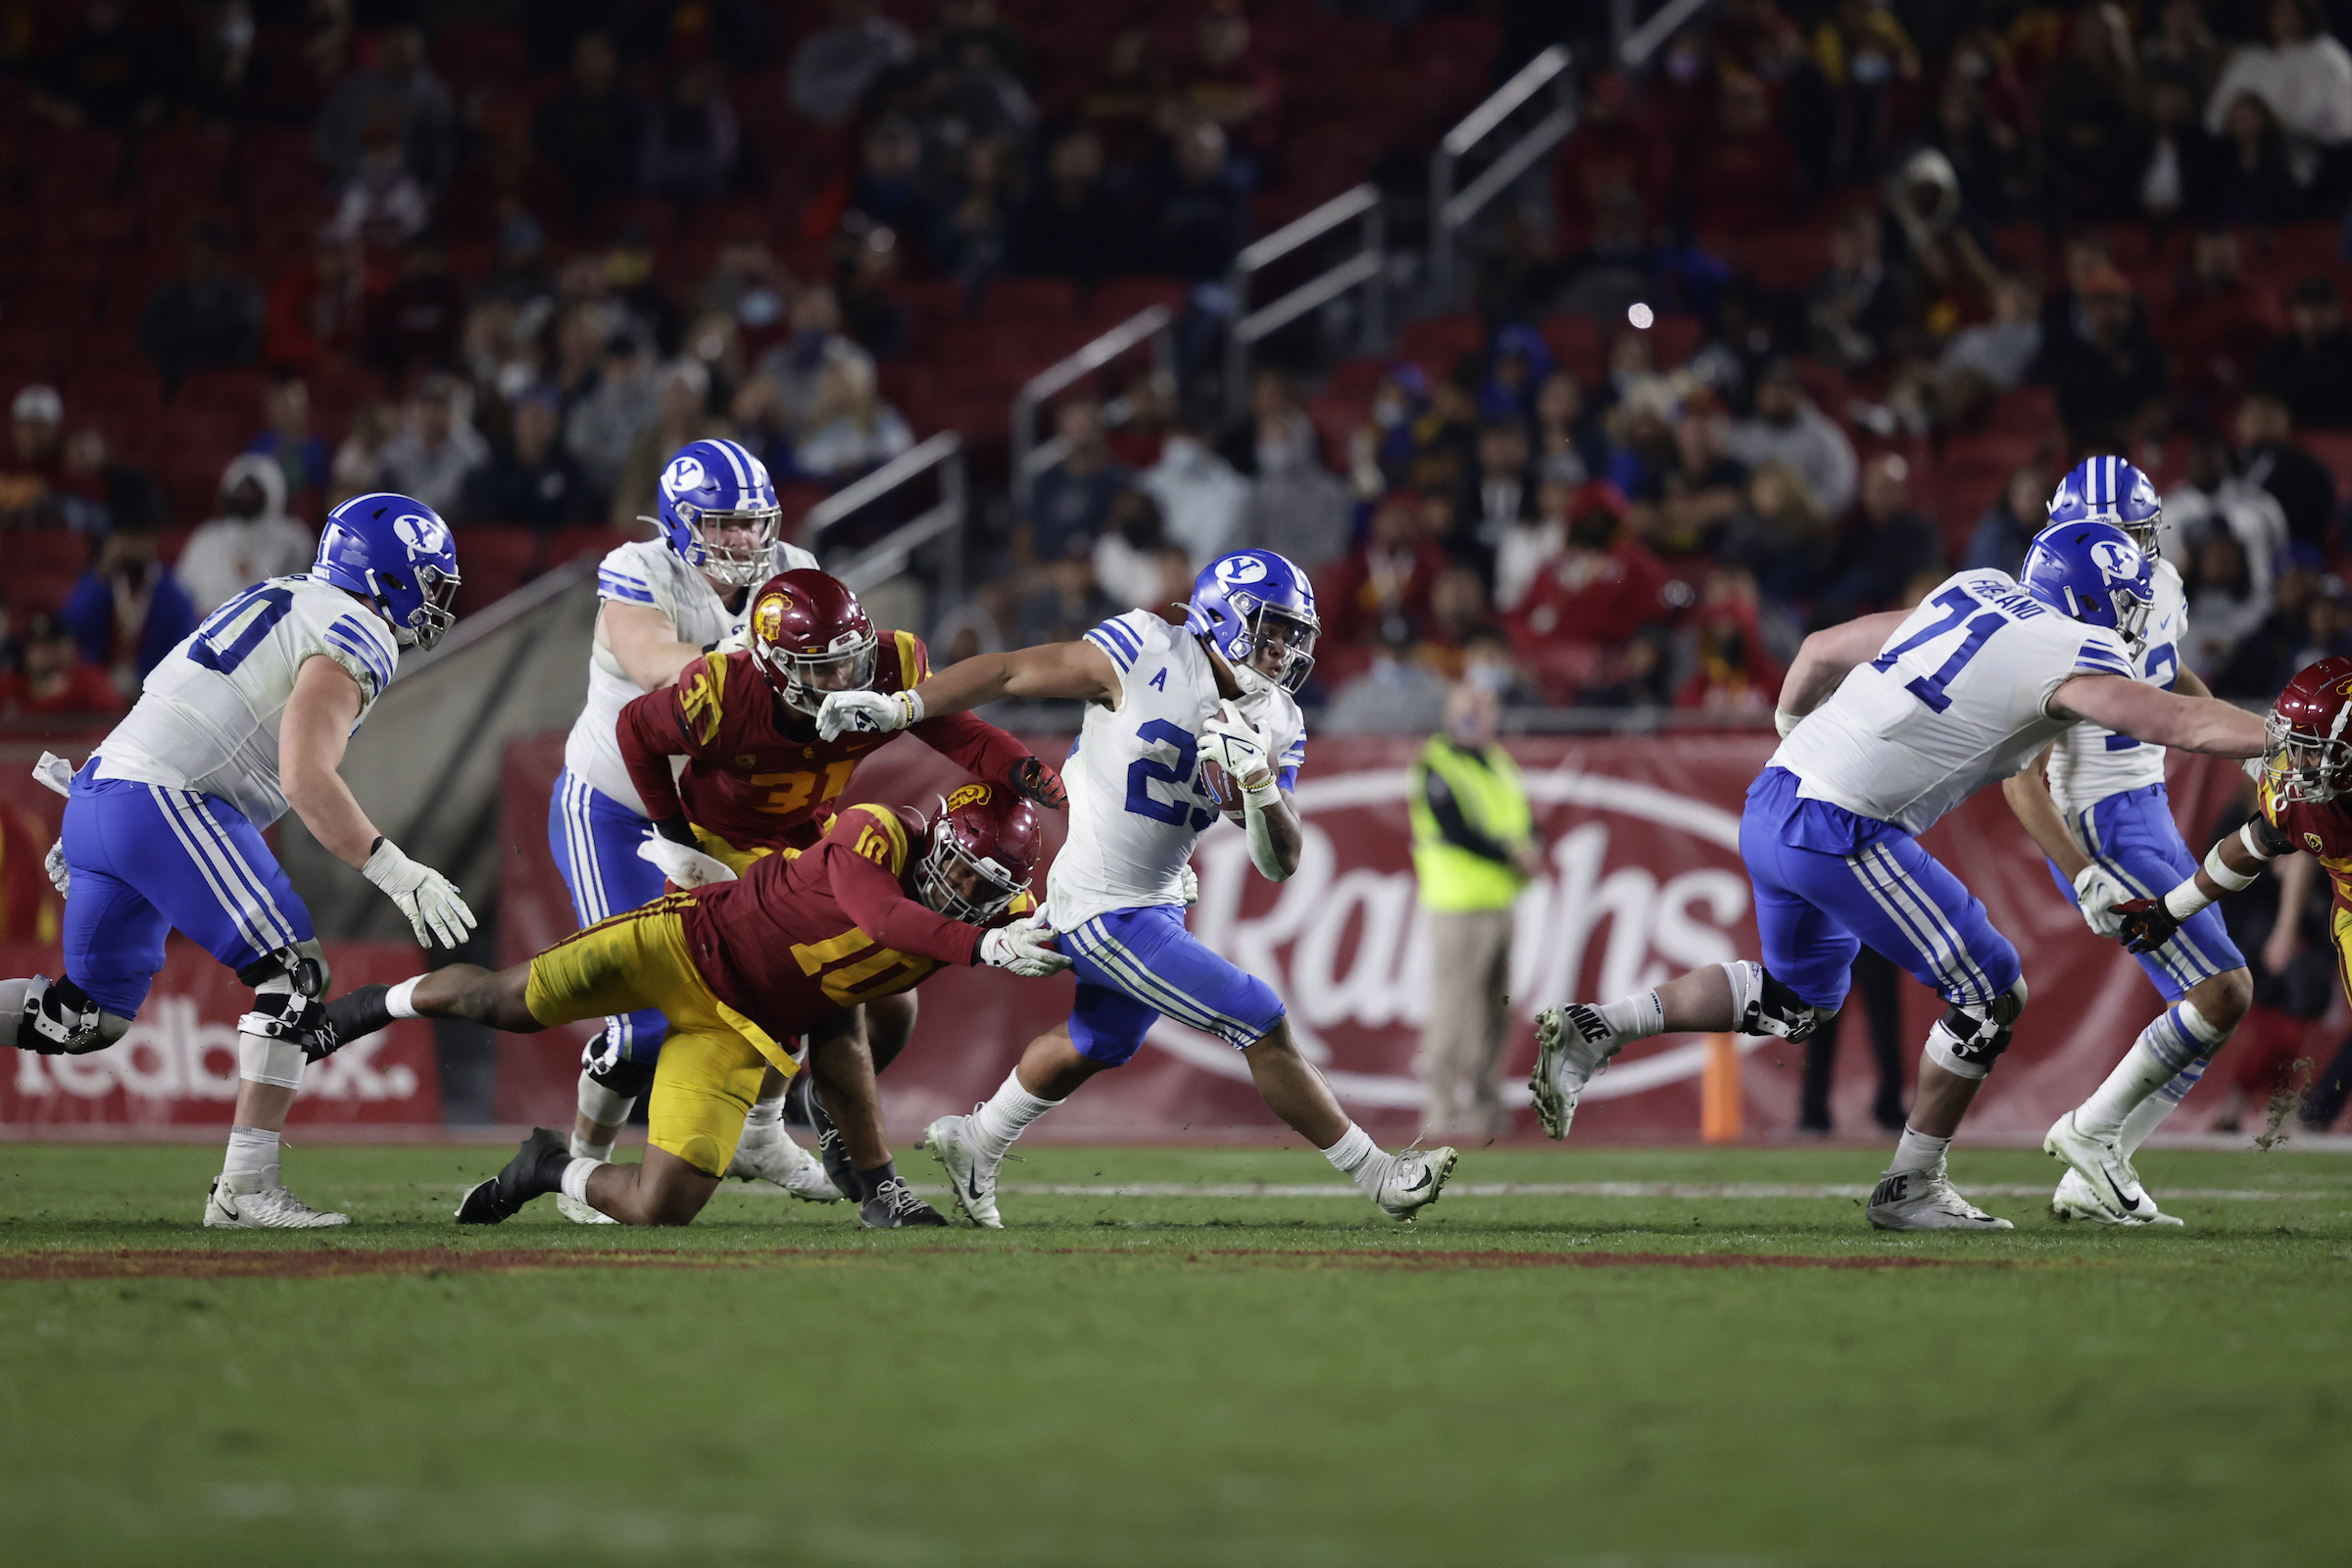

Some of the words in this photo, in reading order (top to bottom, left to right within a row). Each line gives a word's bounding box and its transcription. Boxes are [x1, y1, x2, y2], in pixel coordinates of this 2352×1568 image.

[674, 461, 698, 496] Y
[403, 516, 438, 548] Y
[1227, 557, 1260, 579] Y
[2100, 544, 2133, 575] Y
[1870, 586, 2010, 714] 71
[1148, 666, 1168, 693] A
[750, 760, 857, 814] 31
[853, 824, 890, 865] 10
[1196, 819, 1750, 1066] Rahs
[789, 925, 934, 1008] 10
[1564, 1004, 1612, 1045] NIKE
[1867, 1175, 1909, 1208] NIKE
